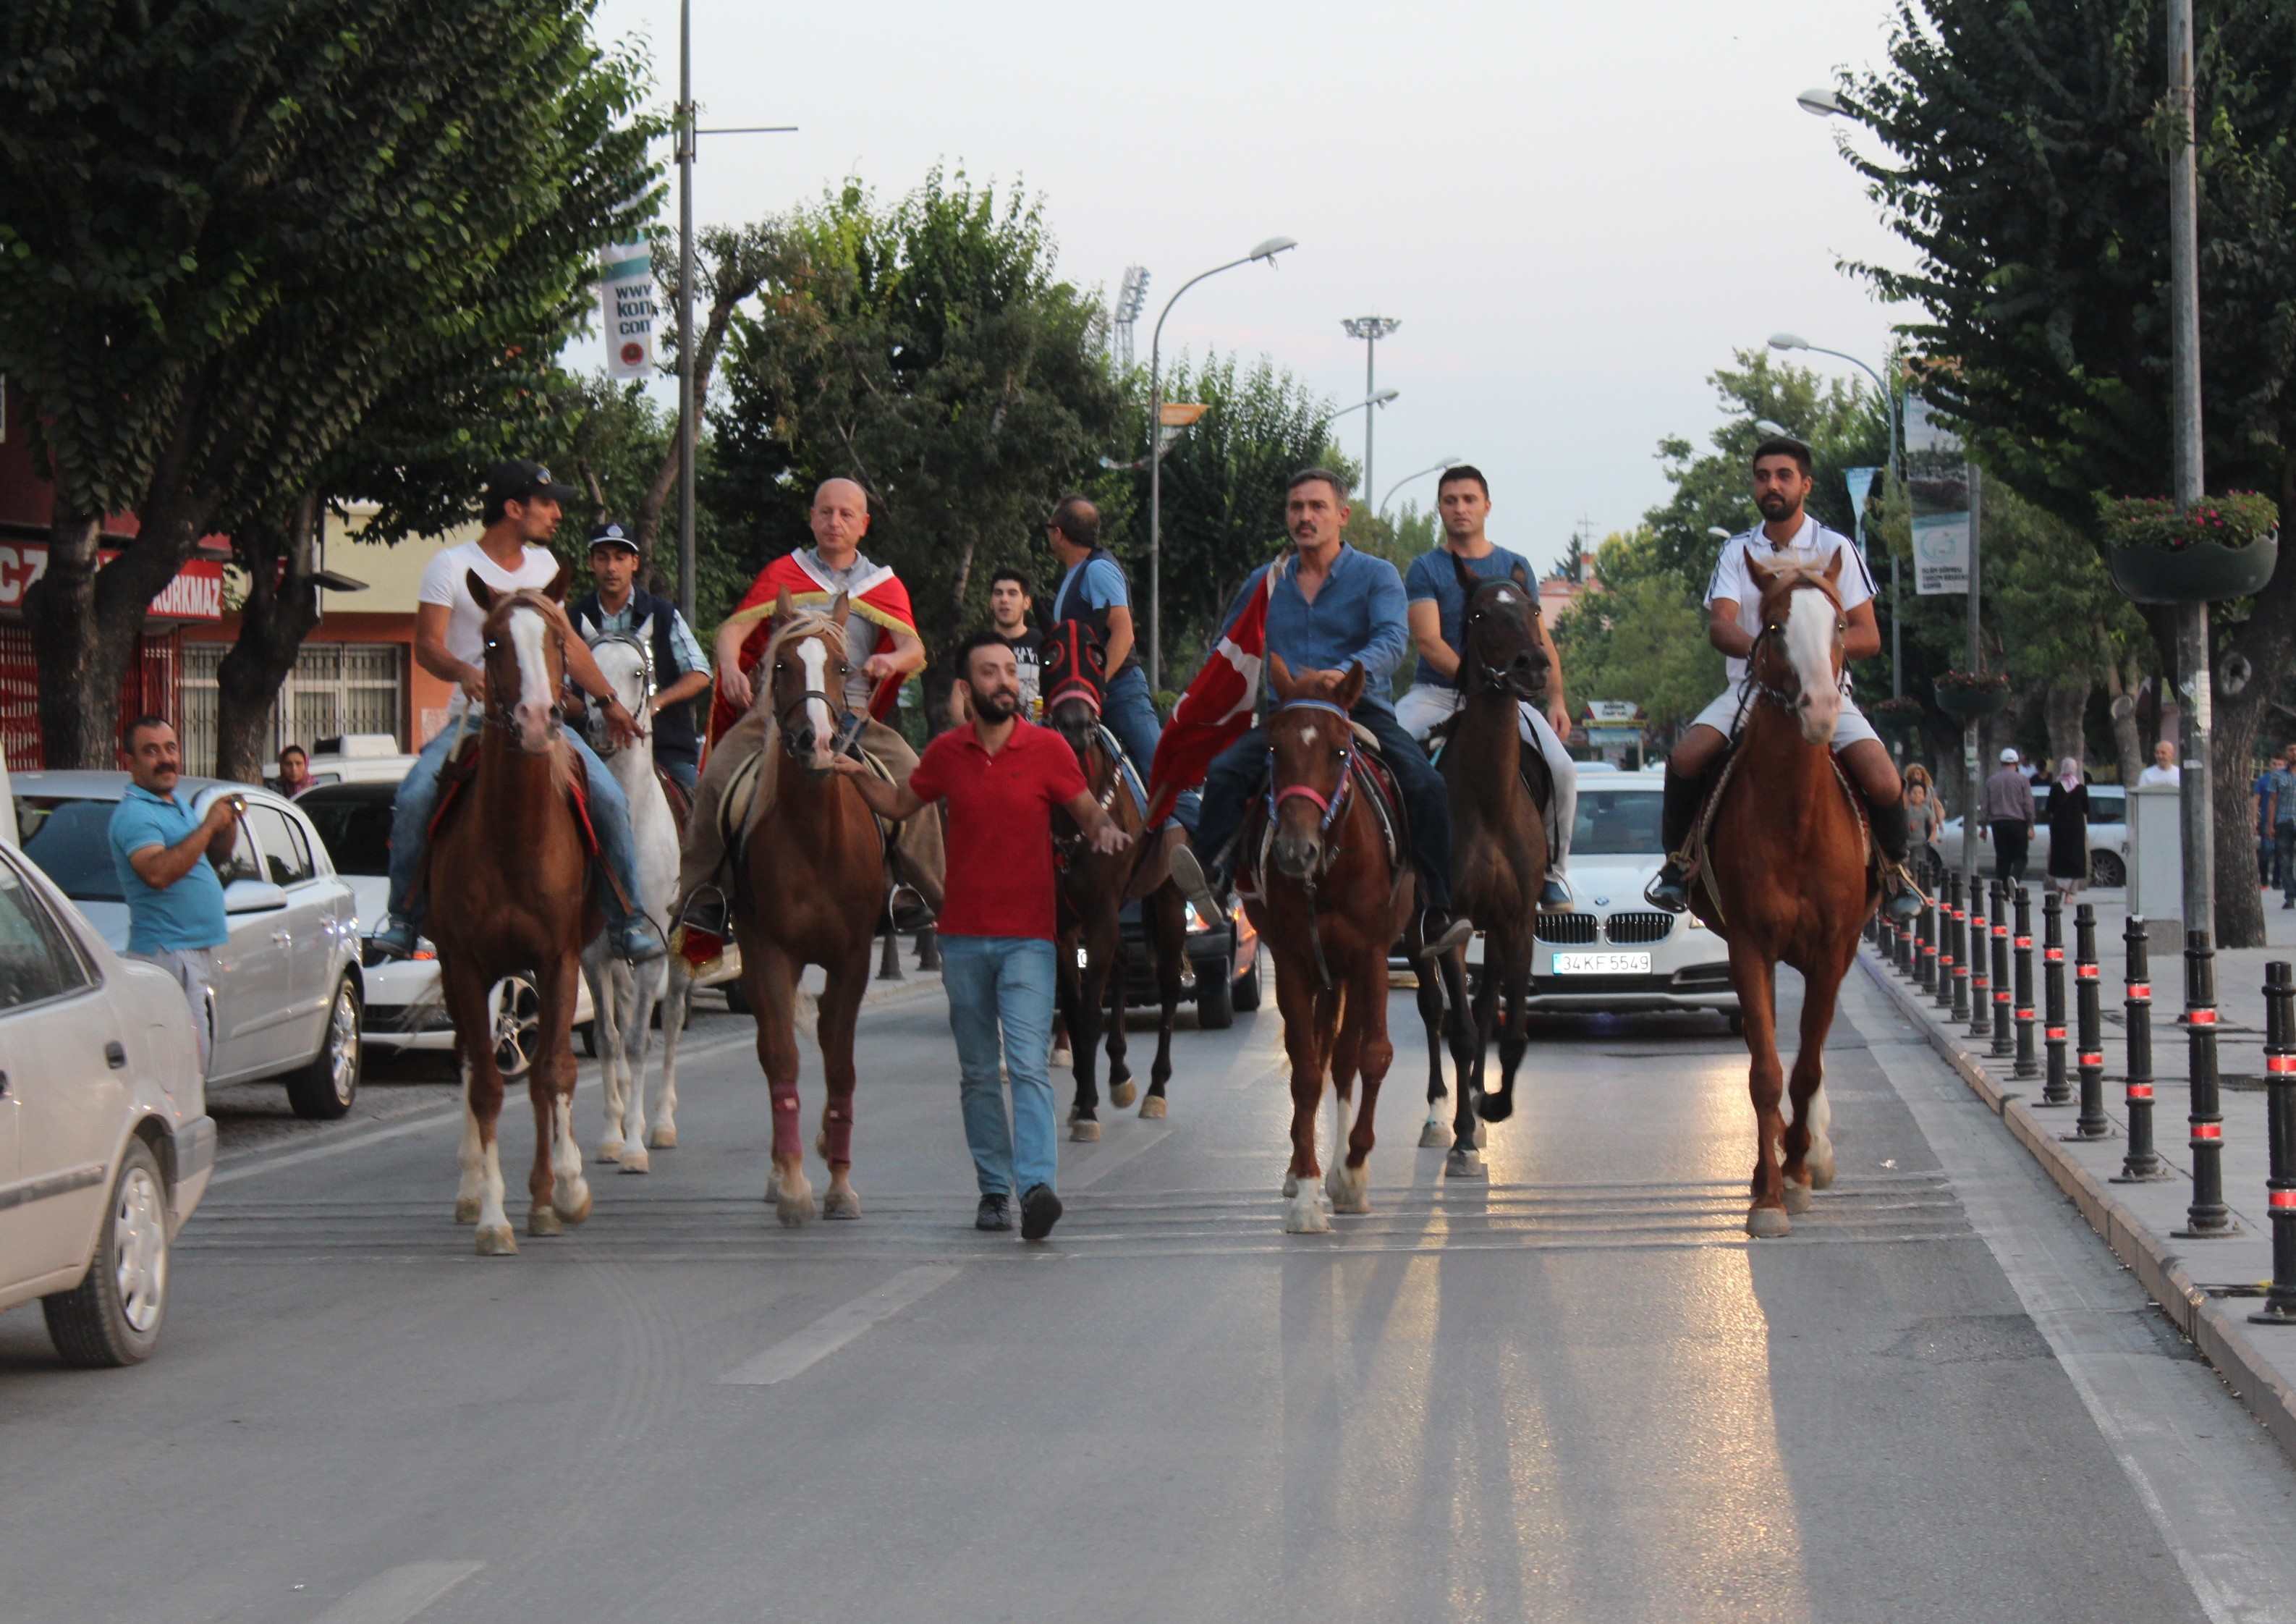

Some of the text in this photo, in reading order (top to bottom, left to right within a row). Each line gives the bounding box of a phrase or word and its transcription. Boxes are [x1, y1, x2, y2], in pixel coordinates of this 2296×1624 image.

[1563, 955, 1648, 970] 34 KF 5549
